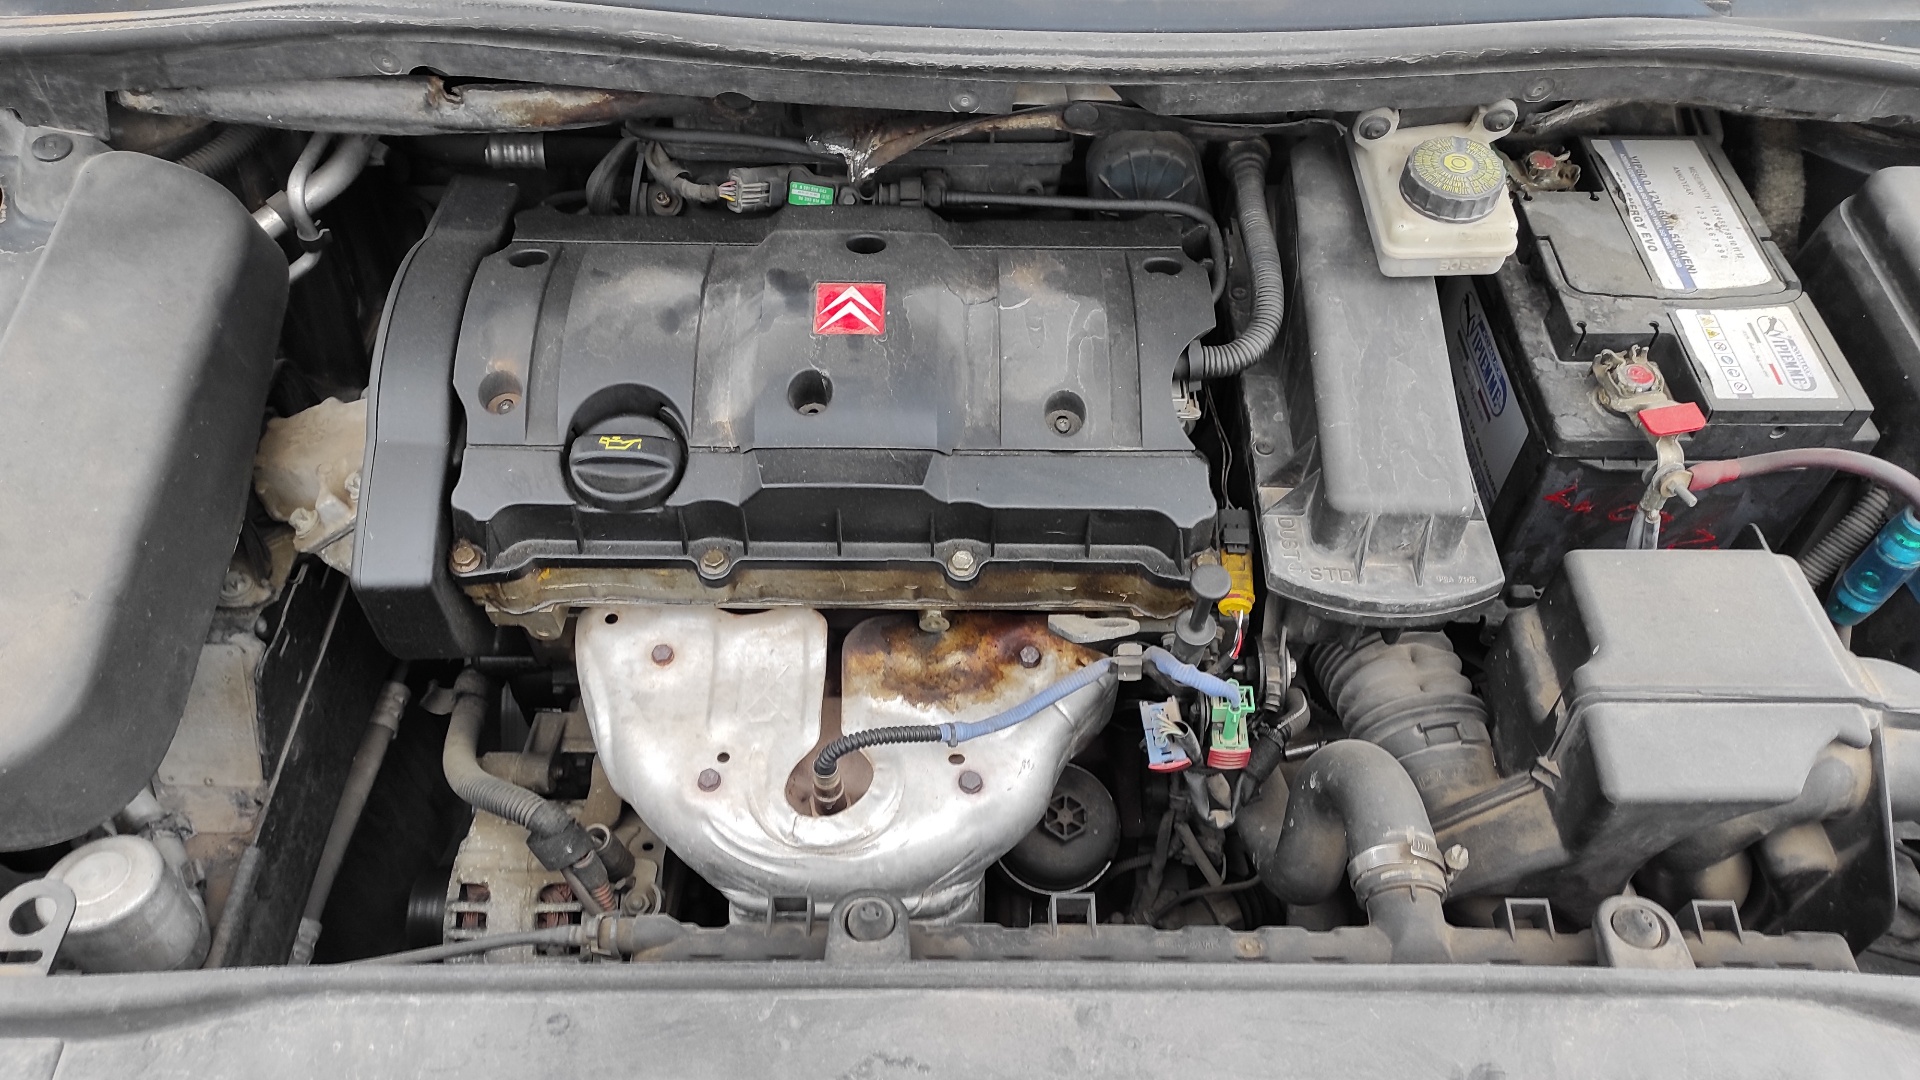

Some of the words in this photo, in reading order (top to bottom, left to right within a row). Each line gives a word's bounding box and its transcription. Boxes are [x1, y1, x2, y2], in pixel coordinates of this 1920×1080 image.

[1647, 190, 1663, 207] 12V
[1641, 232, 1658, 252] EVO
[1310, 567, 1355, 583] STD
